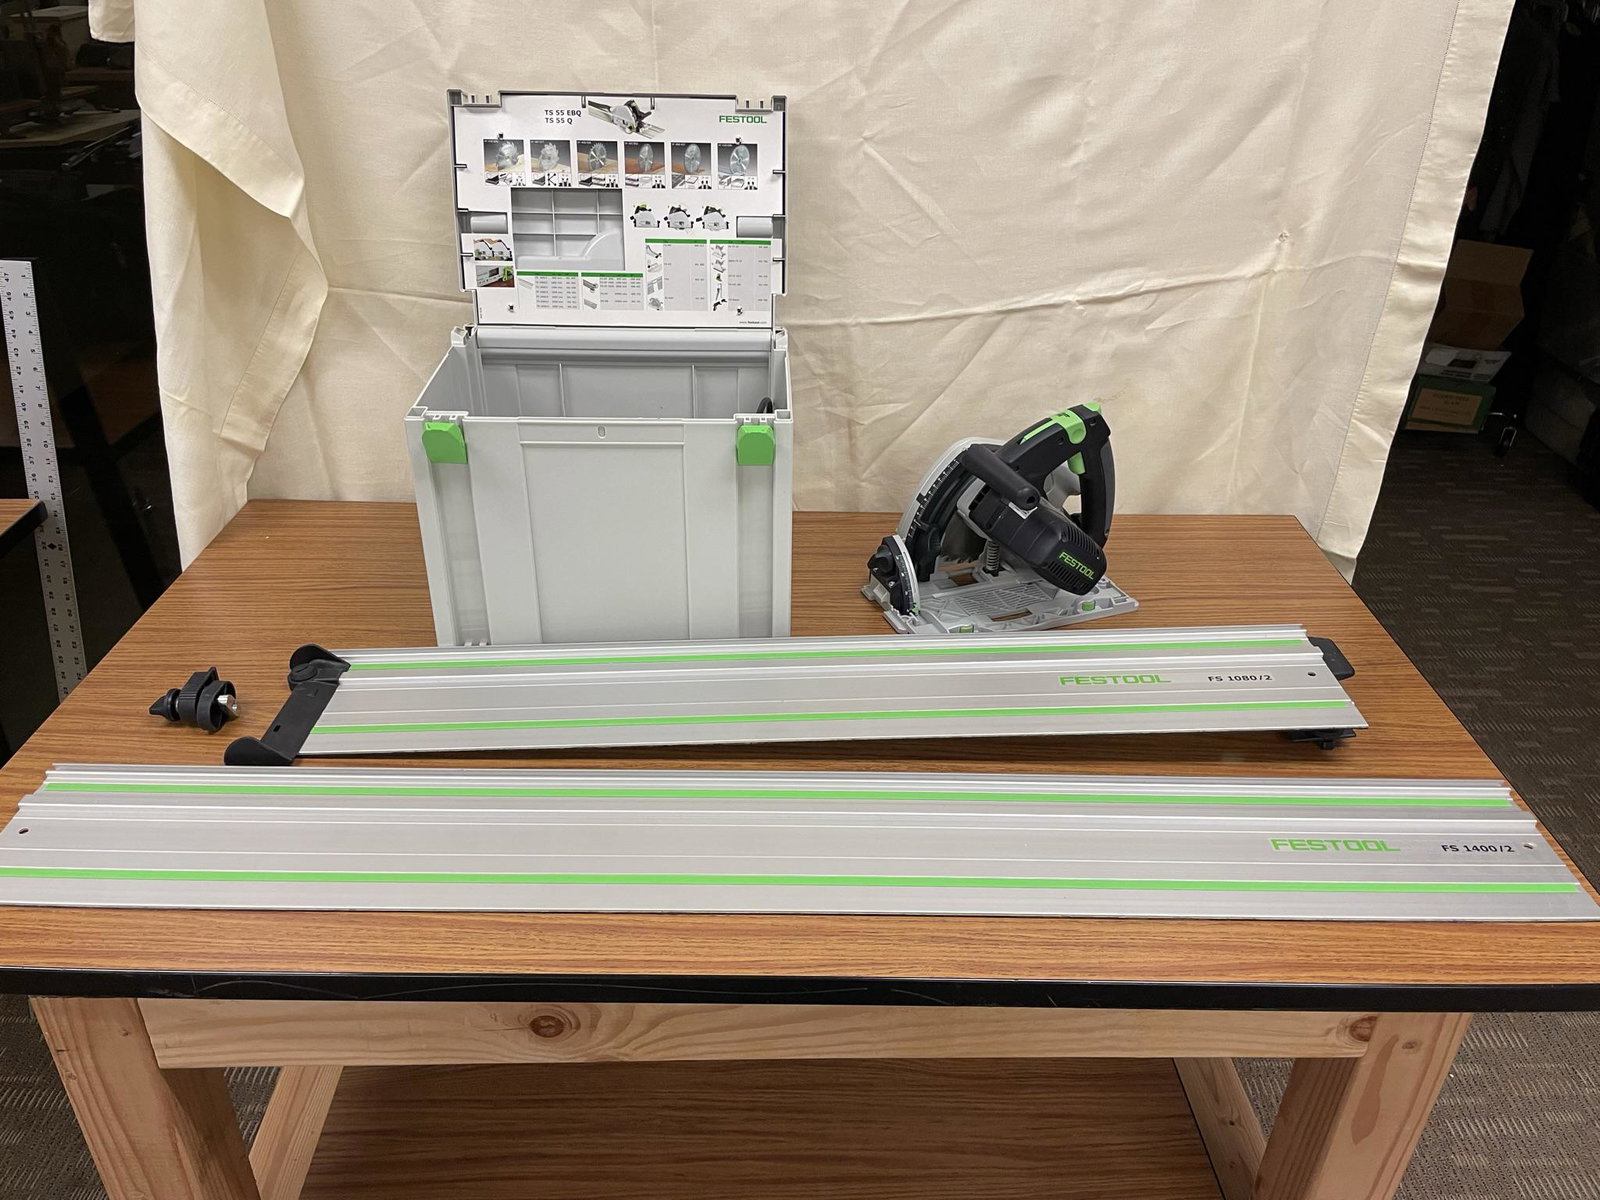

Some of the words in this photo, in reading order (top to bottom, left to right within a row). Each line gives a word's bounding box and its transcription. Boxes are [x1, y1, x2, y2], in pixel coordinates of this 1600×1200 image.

[567, 109, 582, 117] EBQ
[566, 117, 573, 125] Q
[718, 115, 767, 124] FESTOOL
[4, 272, 10, 282] 47
[6, 291, 12, 301] 46
[9, 310, 14, 320] 45
[11, 329, 16, 339] 44
[13, 347, 19, 357] 43
[16, 366, 22, 376] 42
[19, 384, 24, 393] 41
[21, 402, 26, 411] 40
[24, 420, 30, 430] 39
[26, 438, 32, 447] 38
[43, 440, 48, 448] 10
[28, 455, 34, 465] 37
[31, 472, 37, 482] 36
[48, 475, 54, 483] 12
[50, 492, 56, 501] 13
[1058, 551, 1096, 580] FESTOOL
[1059, 674, 1172, 686] FESTOOL
[1228, 674, 1273, 682] 1080/2
[1269, 838, 1401, 853] FESTOOL
[1440, 844, 1460, 852] FS
[1463, 844, 1516, 853] 1400/2
